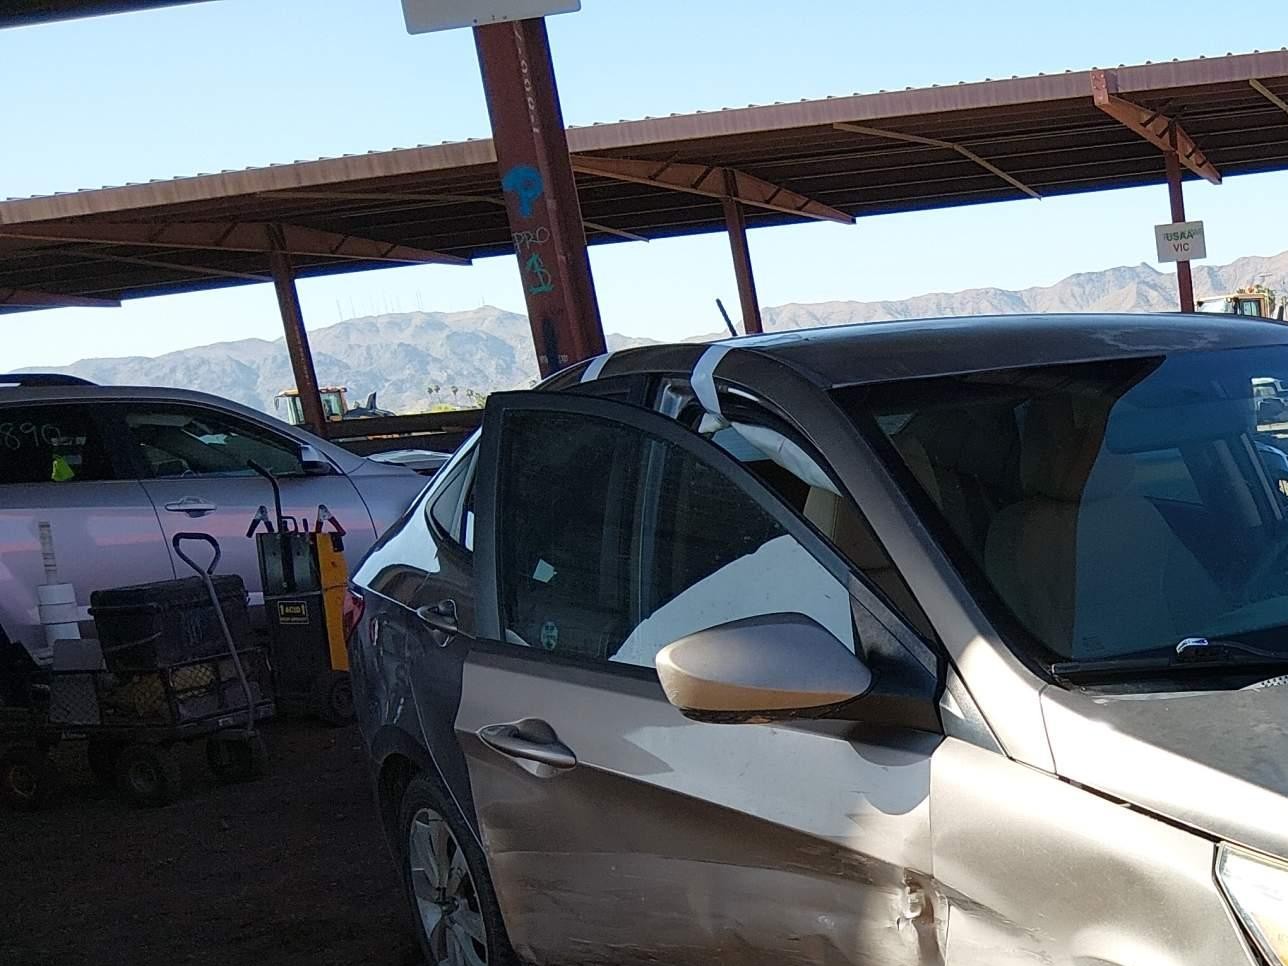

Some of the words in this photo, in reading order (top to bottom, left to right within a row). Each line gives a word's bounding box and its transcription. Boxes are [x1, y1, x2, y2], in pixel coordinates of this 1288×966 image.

[512, 226, 551, 253] PRO
[1165, 231, 1194, 242] USAA
[1172, 242, 1190, 253] VIC
